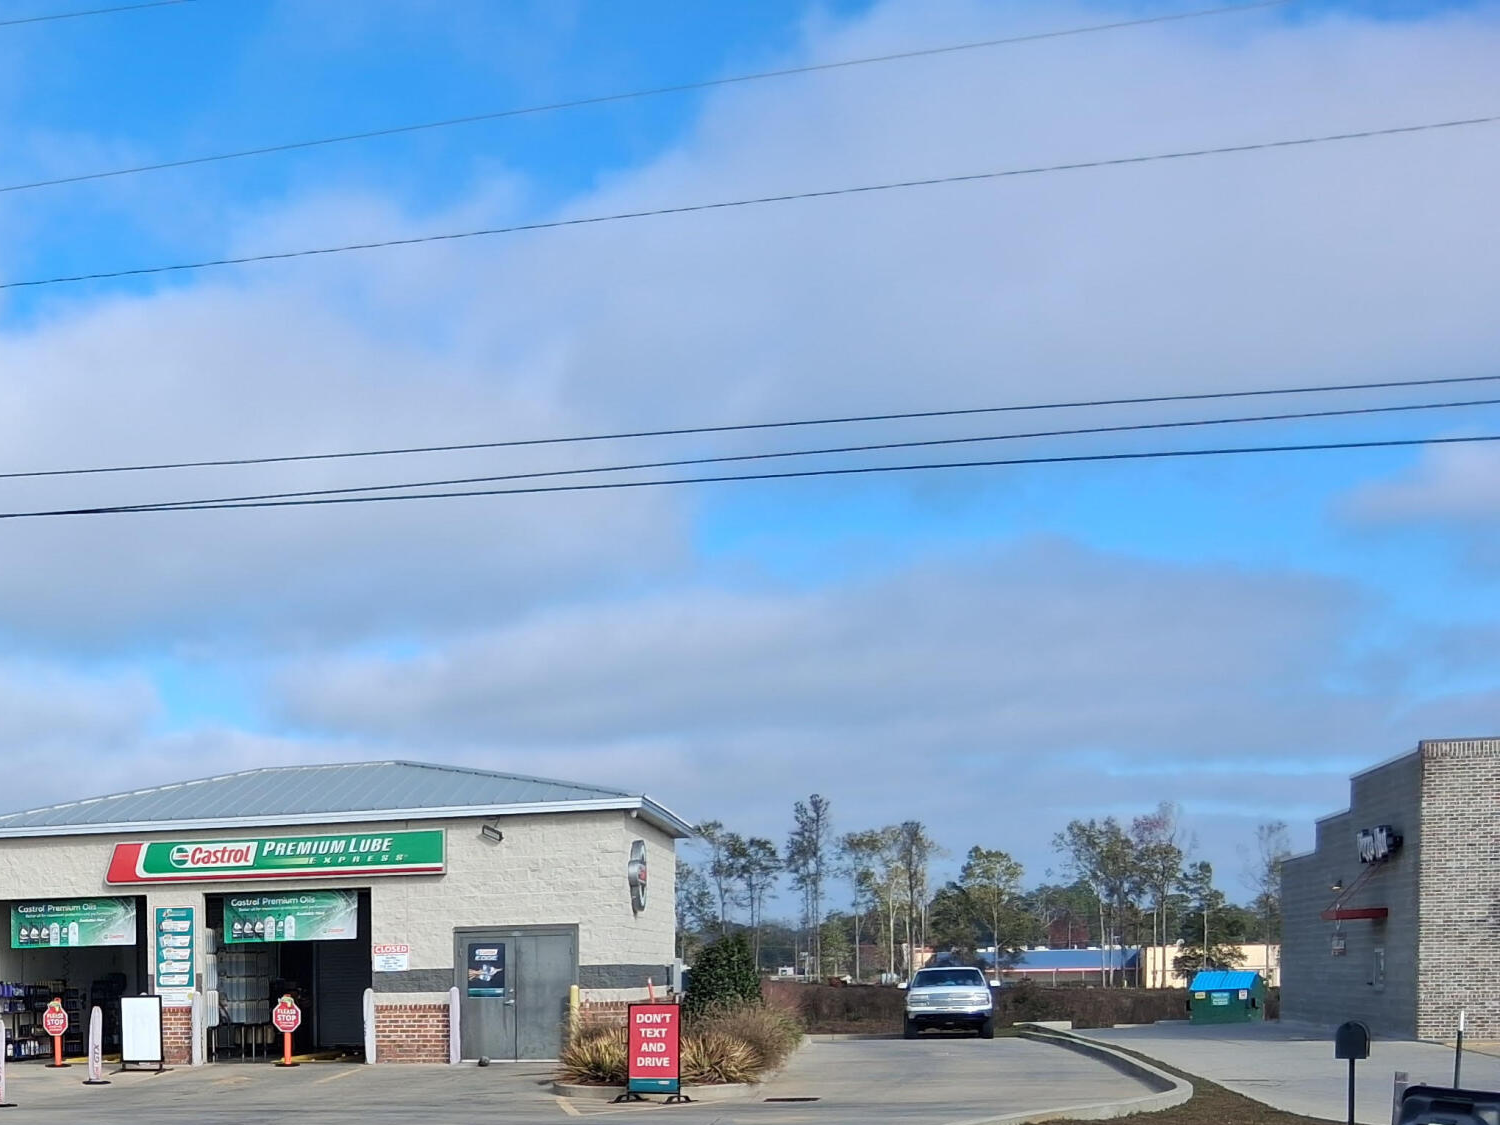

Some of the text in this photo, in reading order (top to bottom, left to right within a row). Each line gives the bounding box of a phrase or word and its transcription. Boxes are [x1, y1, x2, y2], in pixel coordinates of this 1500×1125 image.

[190, 837, 394, 865] Castrol PREMIUM LUBE
[308, 854, 405, 865] EXPRESS
[231, 895, 315, 907] Castrol Premium Oils
[18, 905, 45, 913] Castrol
[47, 903, 80, 912] Premium
[375, 945, 407, 954] CLOSED
[277, 1014, 297, 1022] STOP
[636, 1013, 672, 1024] DON'T
[639, 1028, 668, 1038] TEXT
[640, 1042, 666, 1052] AND
[636, 1056, 670, 1067] DRIVE
